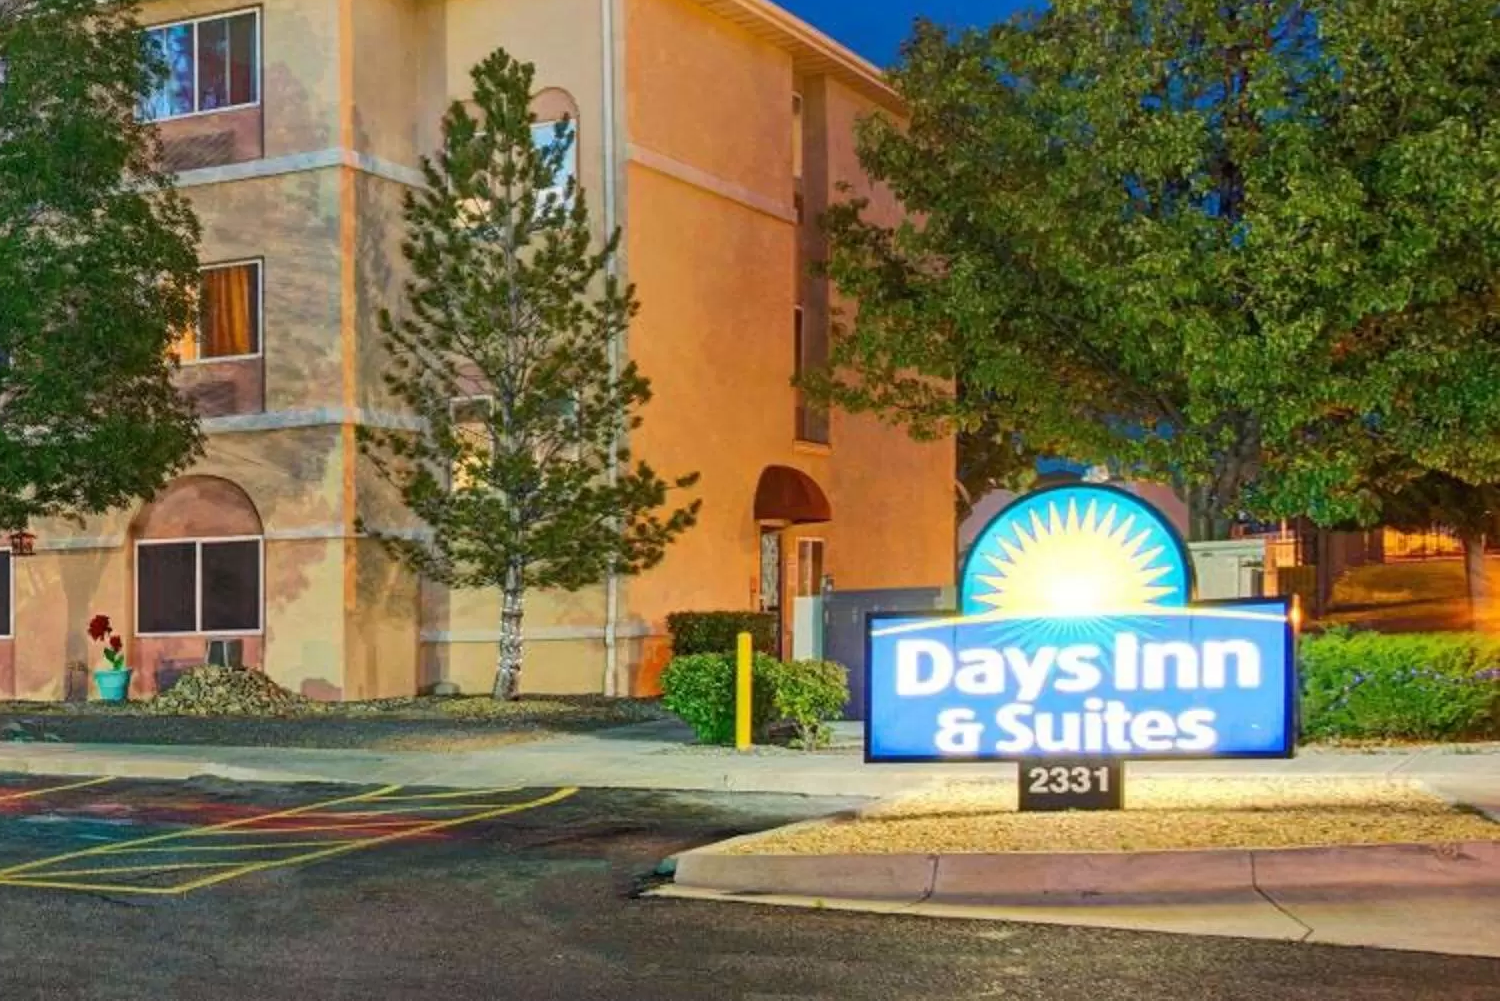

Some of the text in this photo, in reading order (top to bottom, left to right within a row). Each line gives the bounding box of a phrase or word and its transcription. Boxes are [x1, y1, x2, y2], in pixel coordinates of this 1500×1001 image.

[894, 632, 1263, 700] Days Inn
[934, 697, 1218, 753] & Suites
[1028, 766, 1111, 794] 2331
